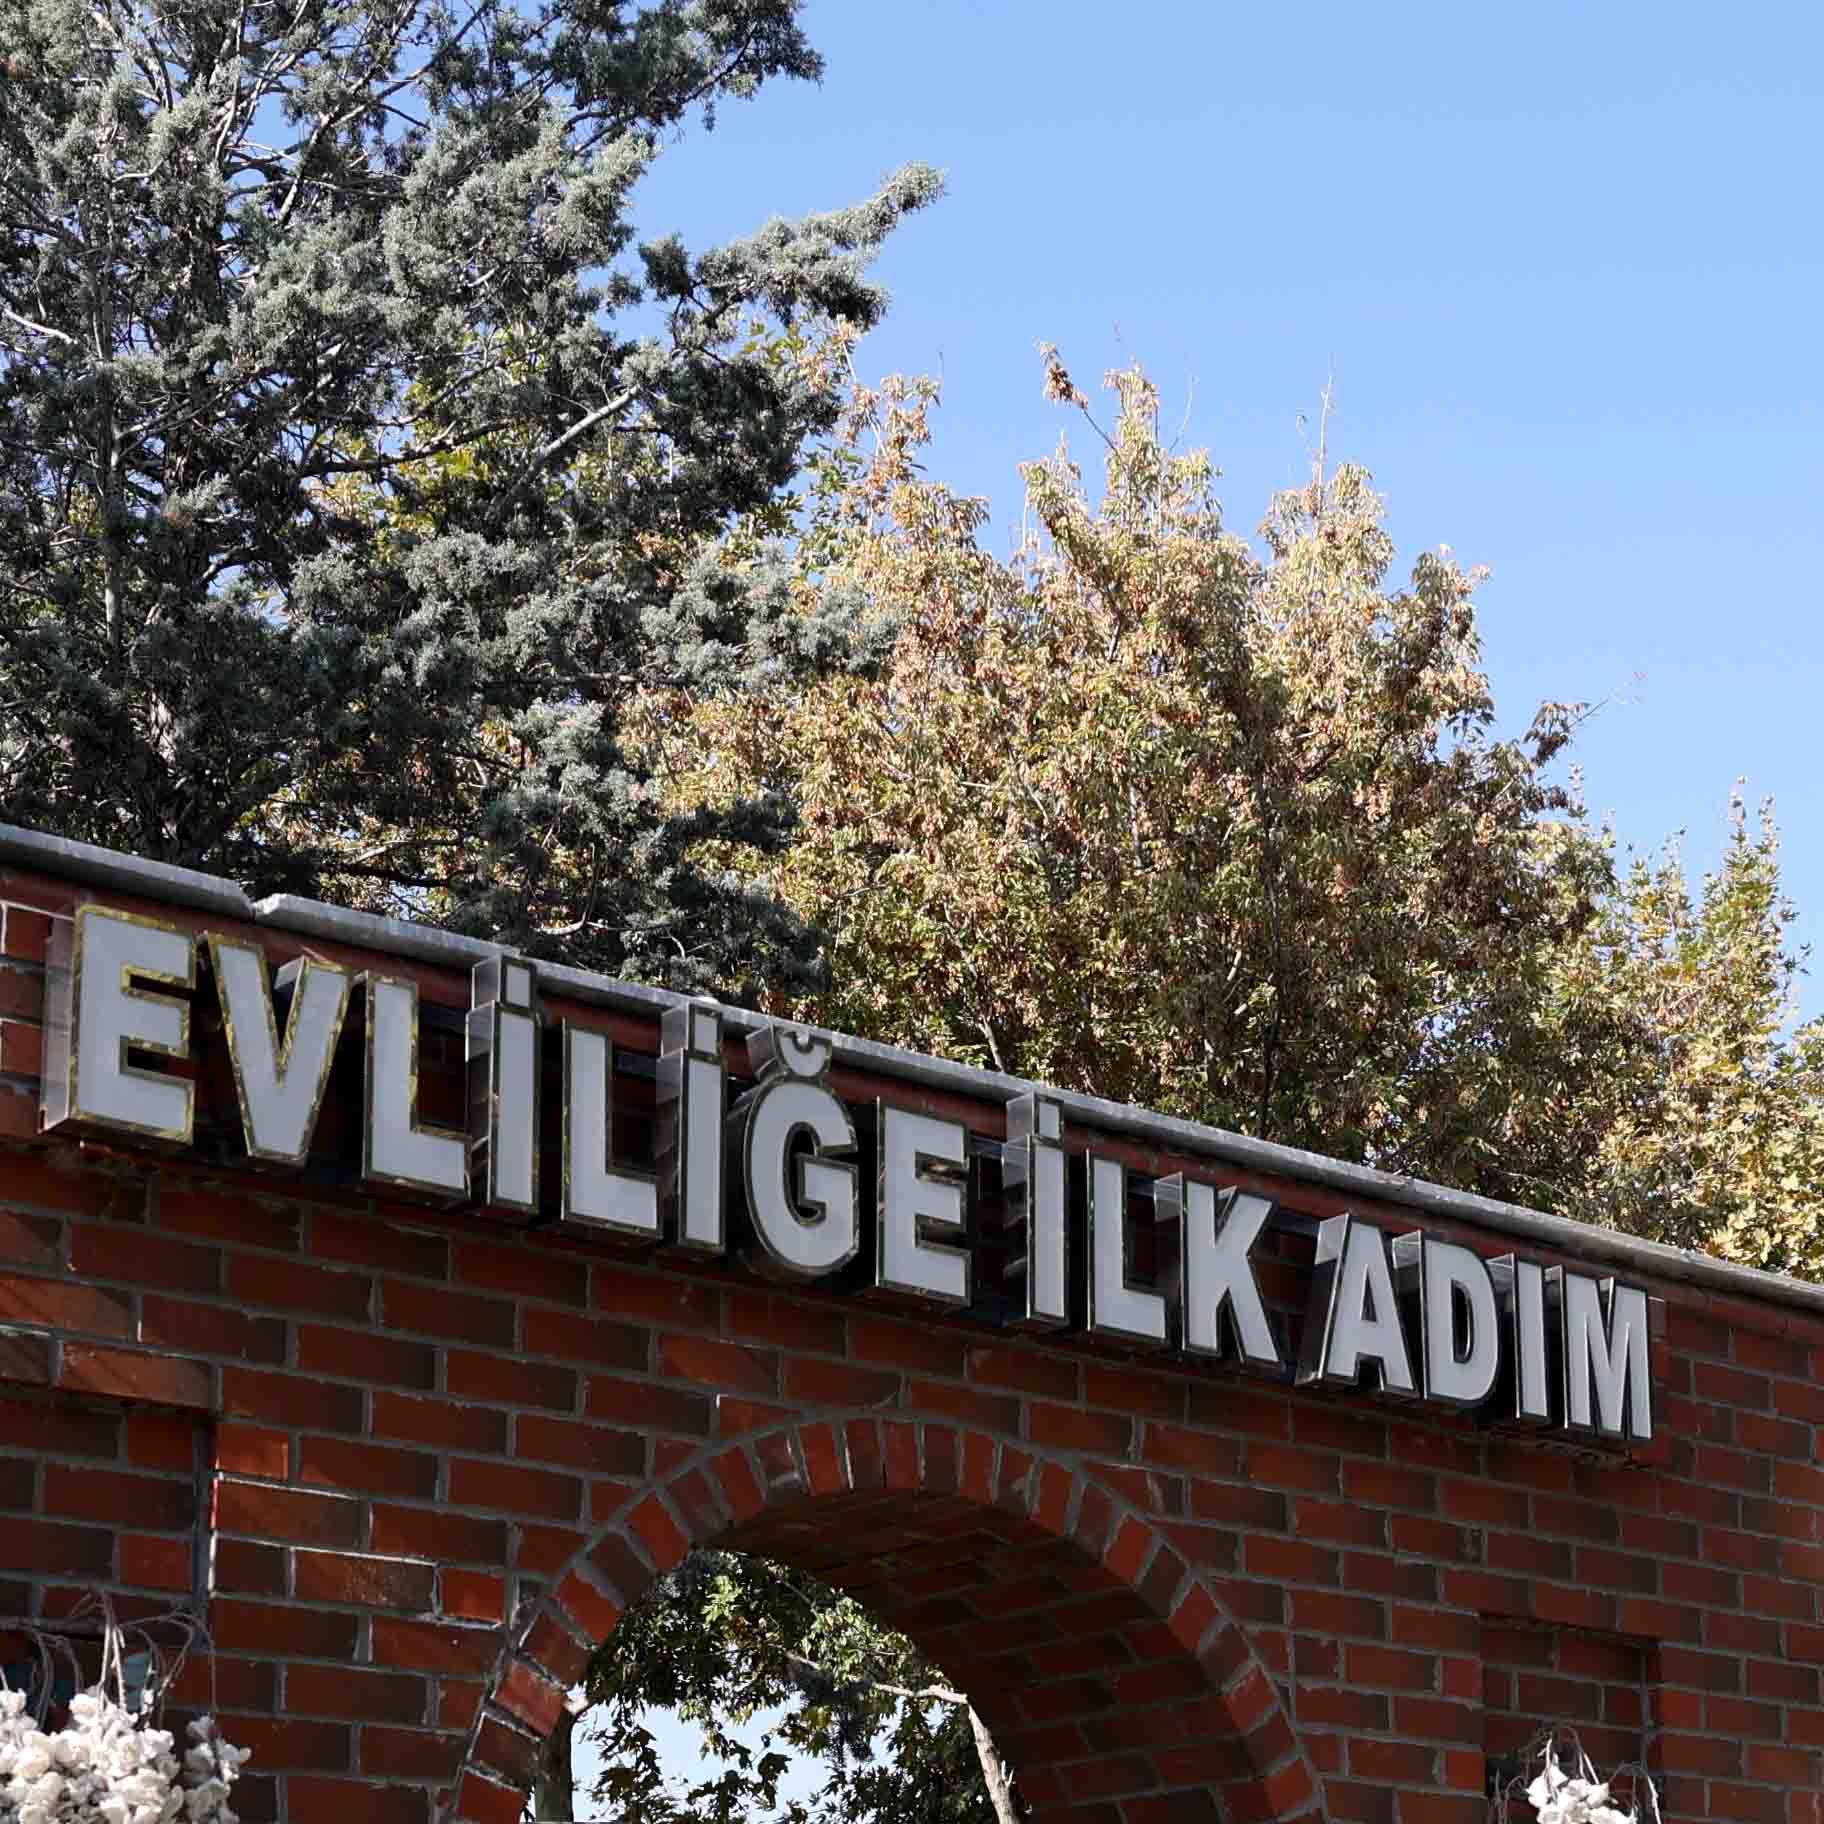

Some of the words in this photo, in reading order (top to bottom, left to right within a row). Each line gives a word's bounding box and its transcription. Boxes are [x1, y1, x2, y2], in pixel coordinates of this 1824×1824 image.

[66, 904, 973, 1306] EVLİLİĞE
[1026, 1092, 1280, 1365] İLK
[1314, 1212, 1655, 1441] ADIM
